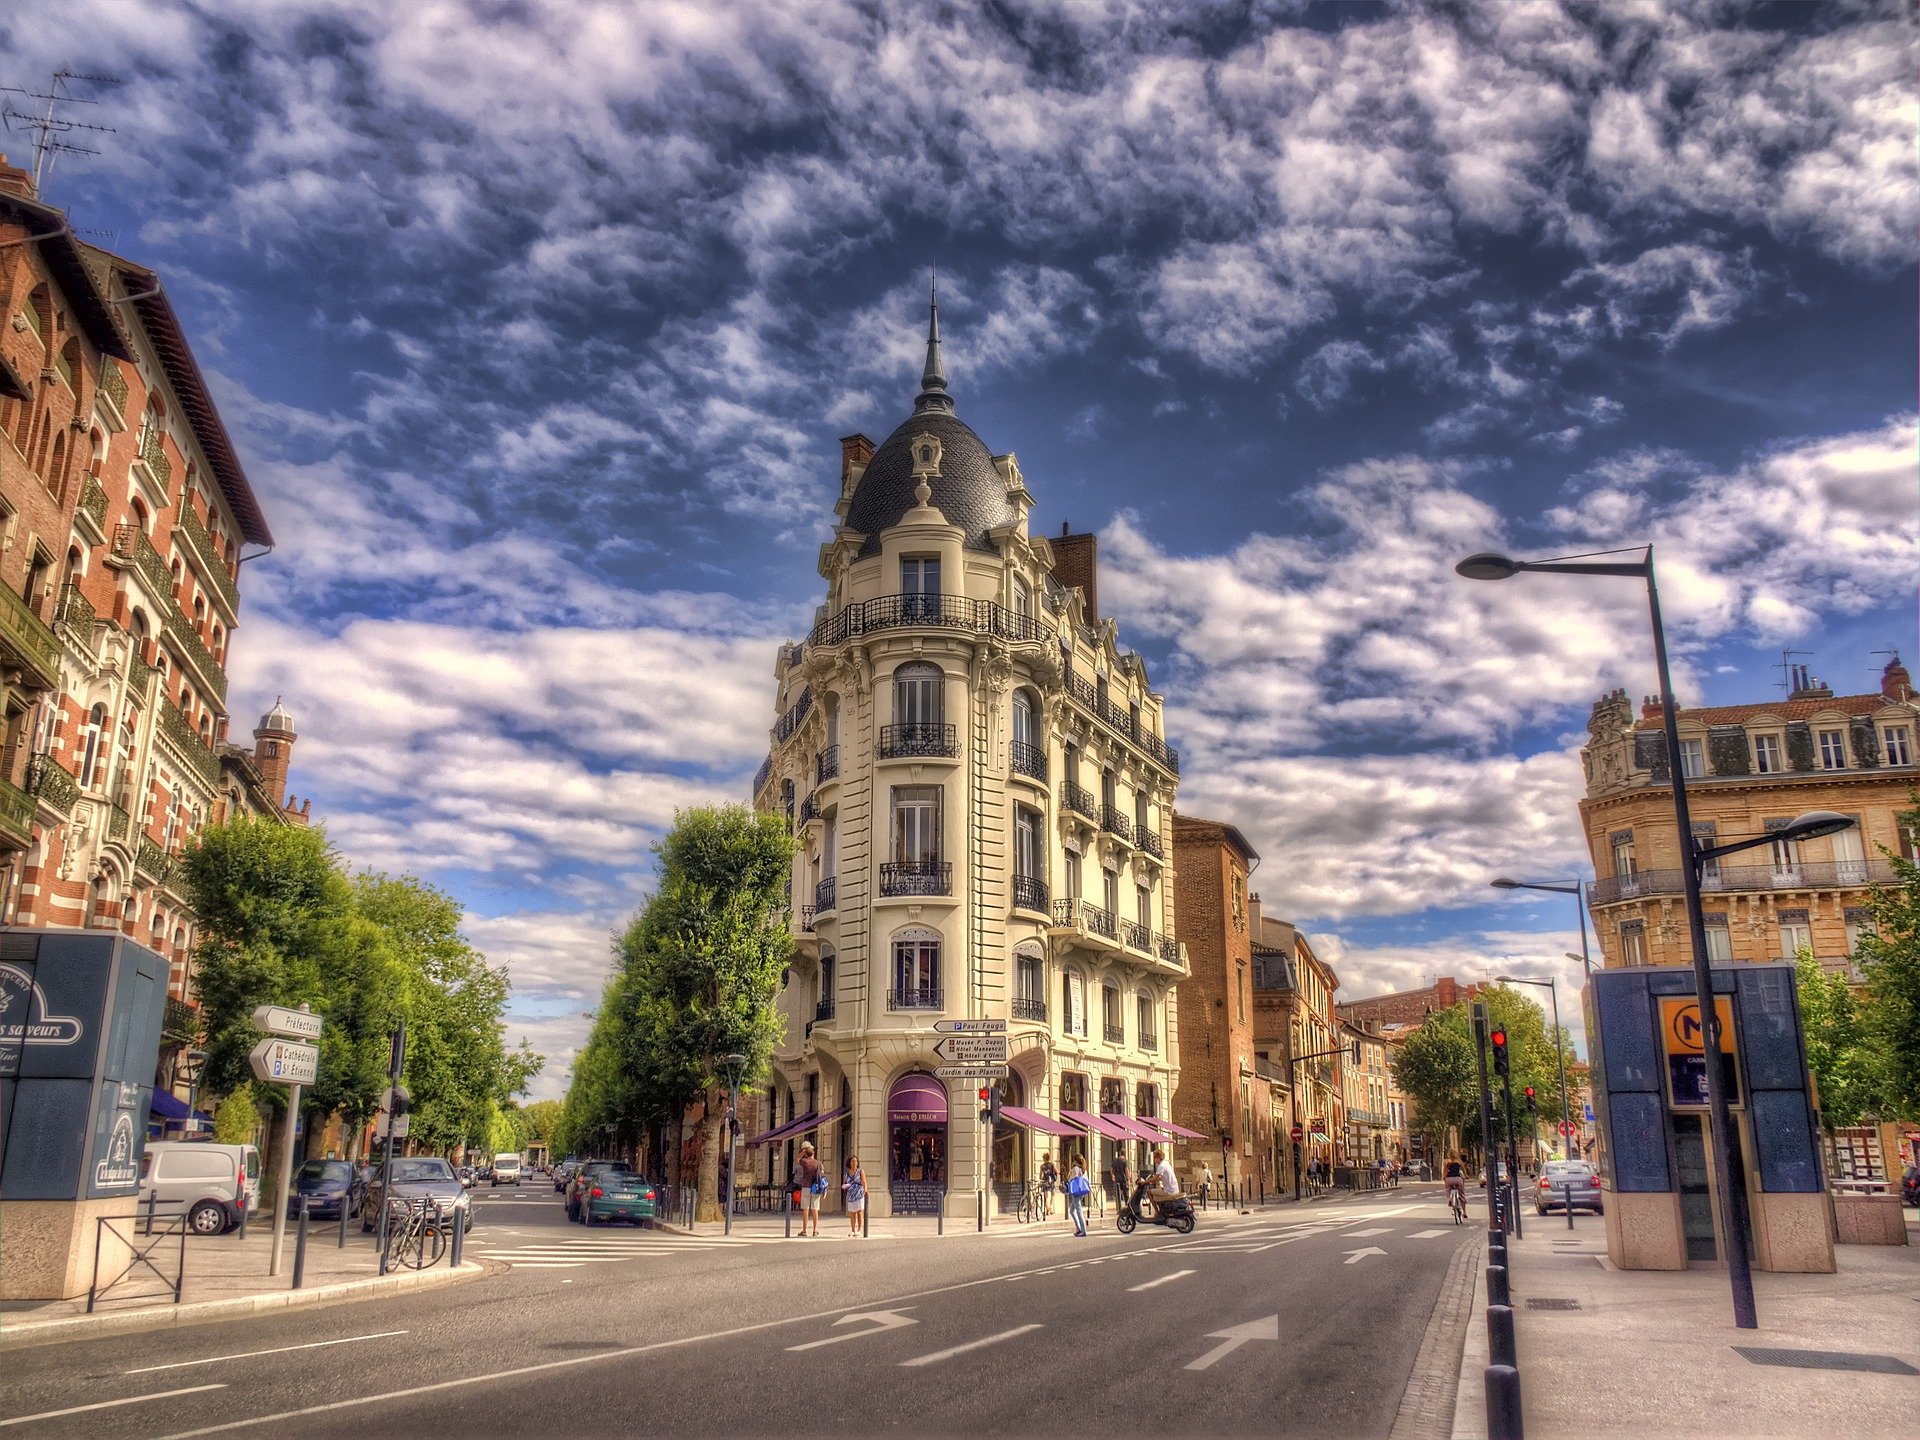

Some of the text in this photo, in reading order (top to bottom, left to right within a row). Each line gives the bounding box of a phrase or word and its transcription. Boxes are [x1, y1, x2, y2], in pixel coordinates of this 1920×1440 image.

[0, 972, 31, 992] INCENT
[8, 1024, 62, 1037] saveurs
[286, 1016, 319, 1032] Préfecture
[284, 1048, 316, 1063] Cathédrale
[291, 1062, 315, 1078] Étienne
